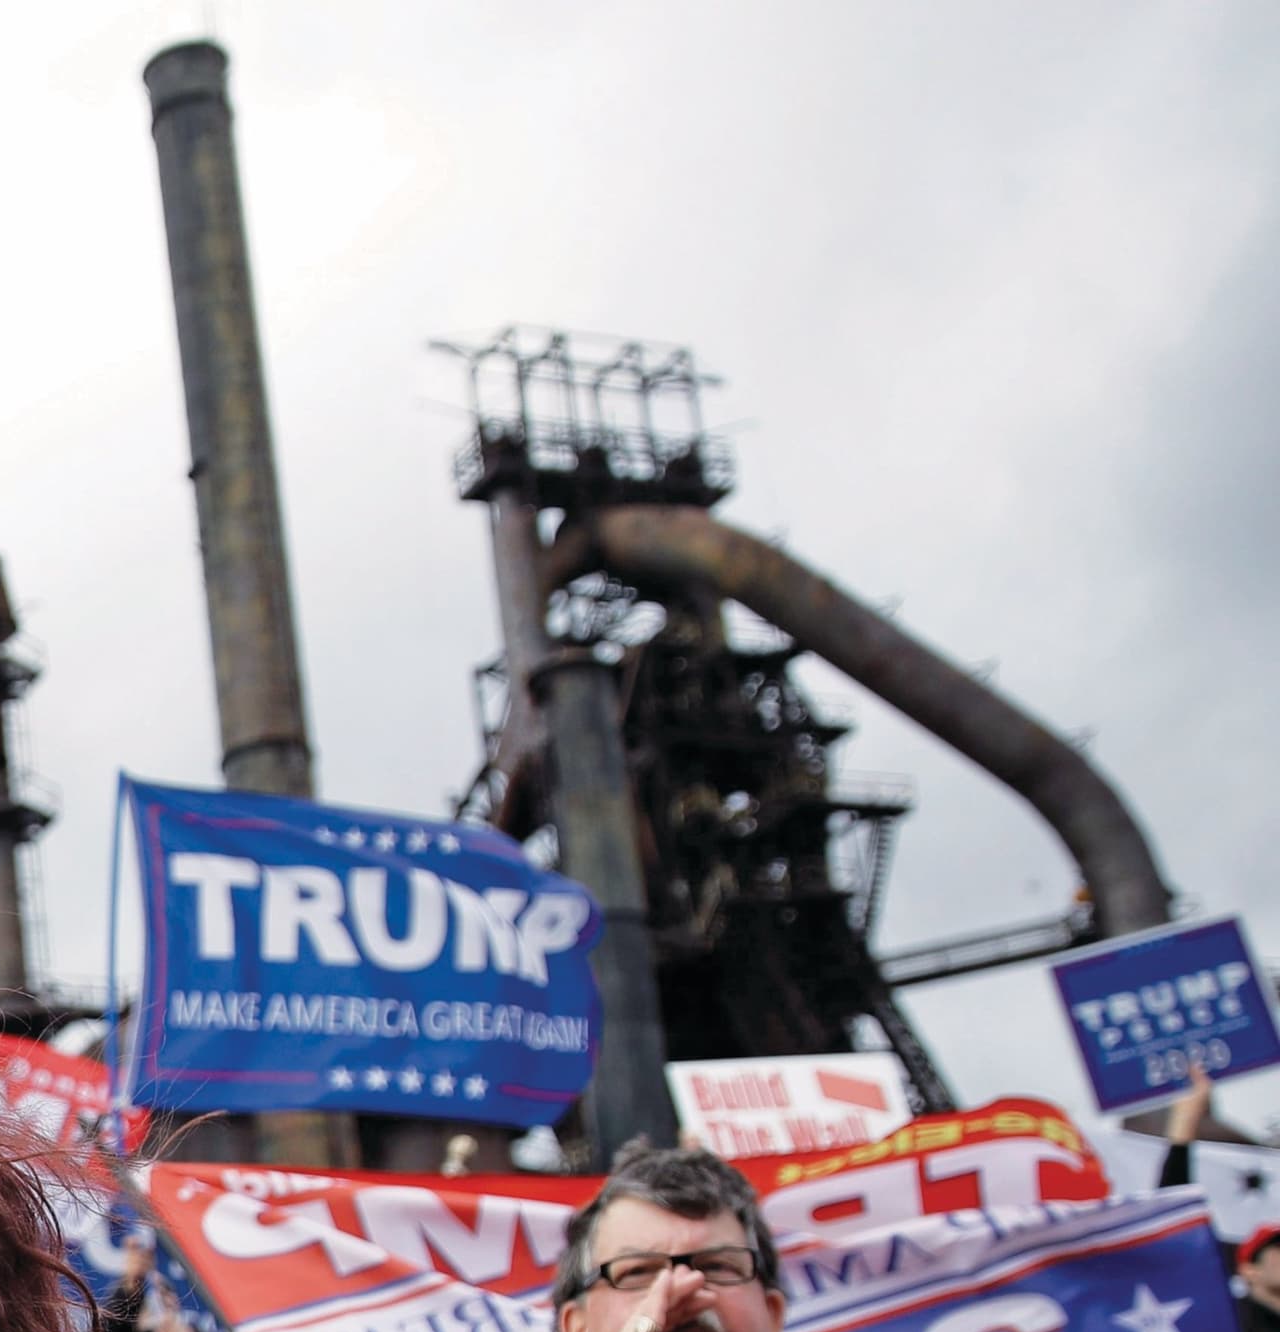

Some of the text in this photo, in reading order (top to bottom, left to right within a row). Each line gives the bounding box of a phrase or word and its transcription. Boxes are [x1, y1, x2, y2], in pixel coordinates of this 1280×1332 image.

[168, 852, 592, 988] TRUMP
[170, 989, 260, 1031] MAKE
[263, 993, 419, 1038] AMERICA
[421, 1000, 524, 1043] GREAT
[1073, 961, 1251, 1033] TRUMP
[690, 1068, 790, 1112] Build
[785, 1107, 868, 1153] Wall
